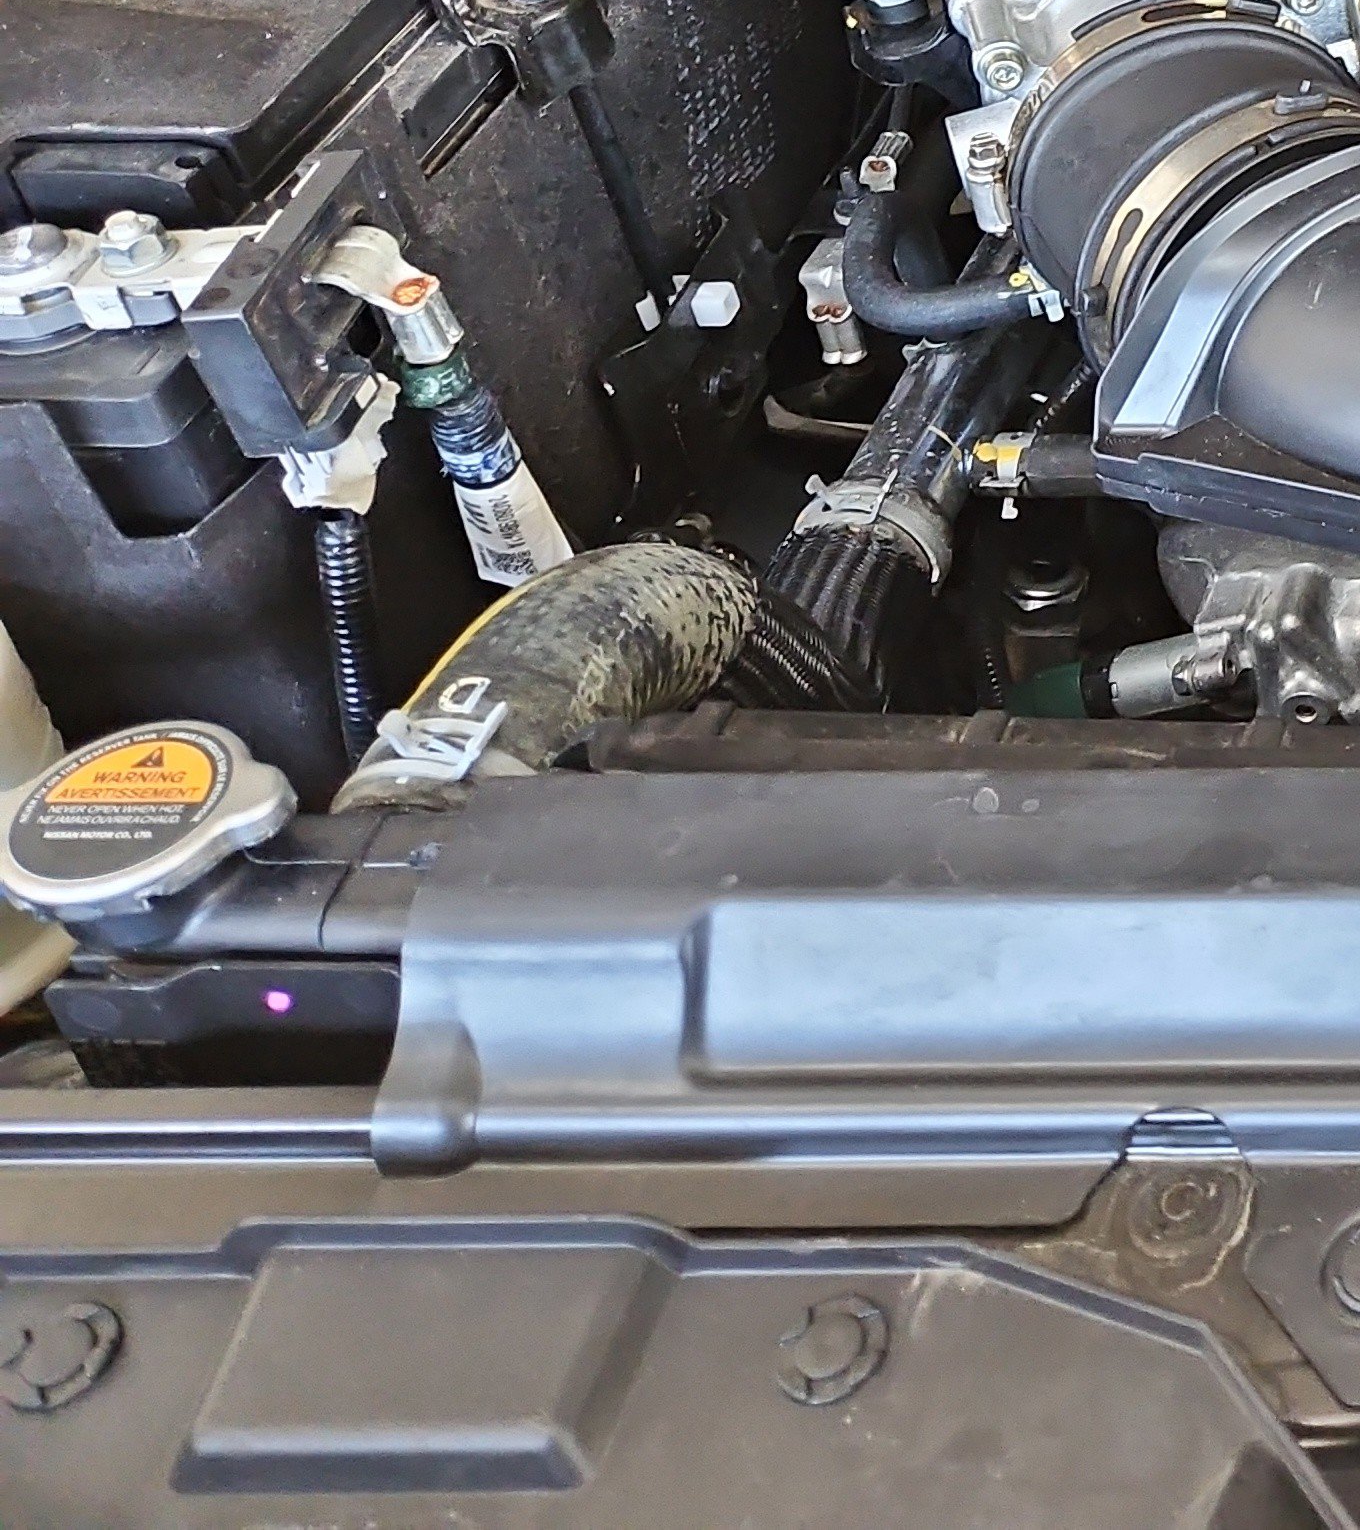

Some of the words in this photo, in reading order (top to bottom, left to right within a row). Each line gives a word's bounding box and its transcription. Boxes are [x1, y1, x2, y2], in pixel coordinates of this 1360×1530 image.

[92, 771, 187, 784] WARNING
[57, 787, 201, 799] AVERTISSEMENT
[47, 804, 87, 814] NEVER
[87, 804, 120, 814] OPEN
[121, 804, 157, 814] WHEN
[43, 831, 79, 840] NISSAN
[79, 831, 115, 840] MOTOR
